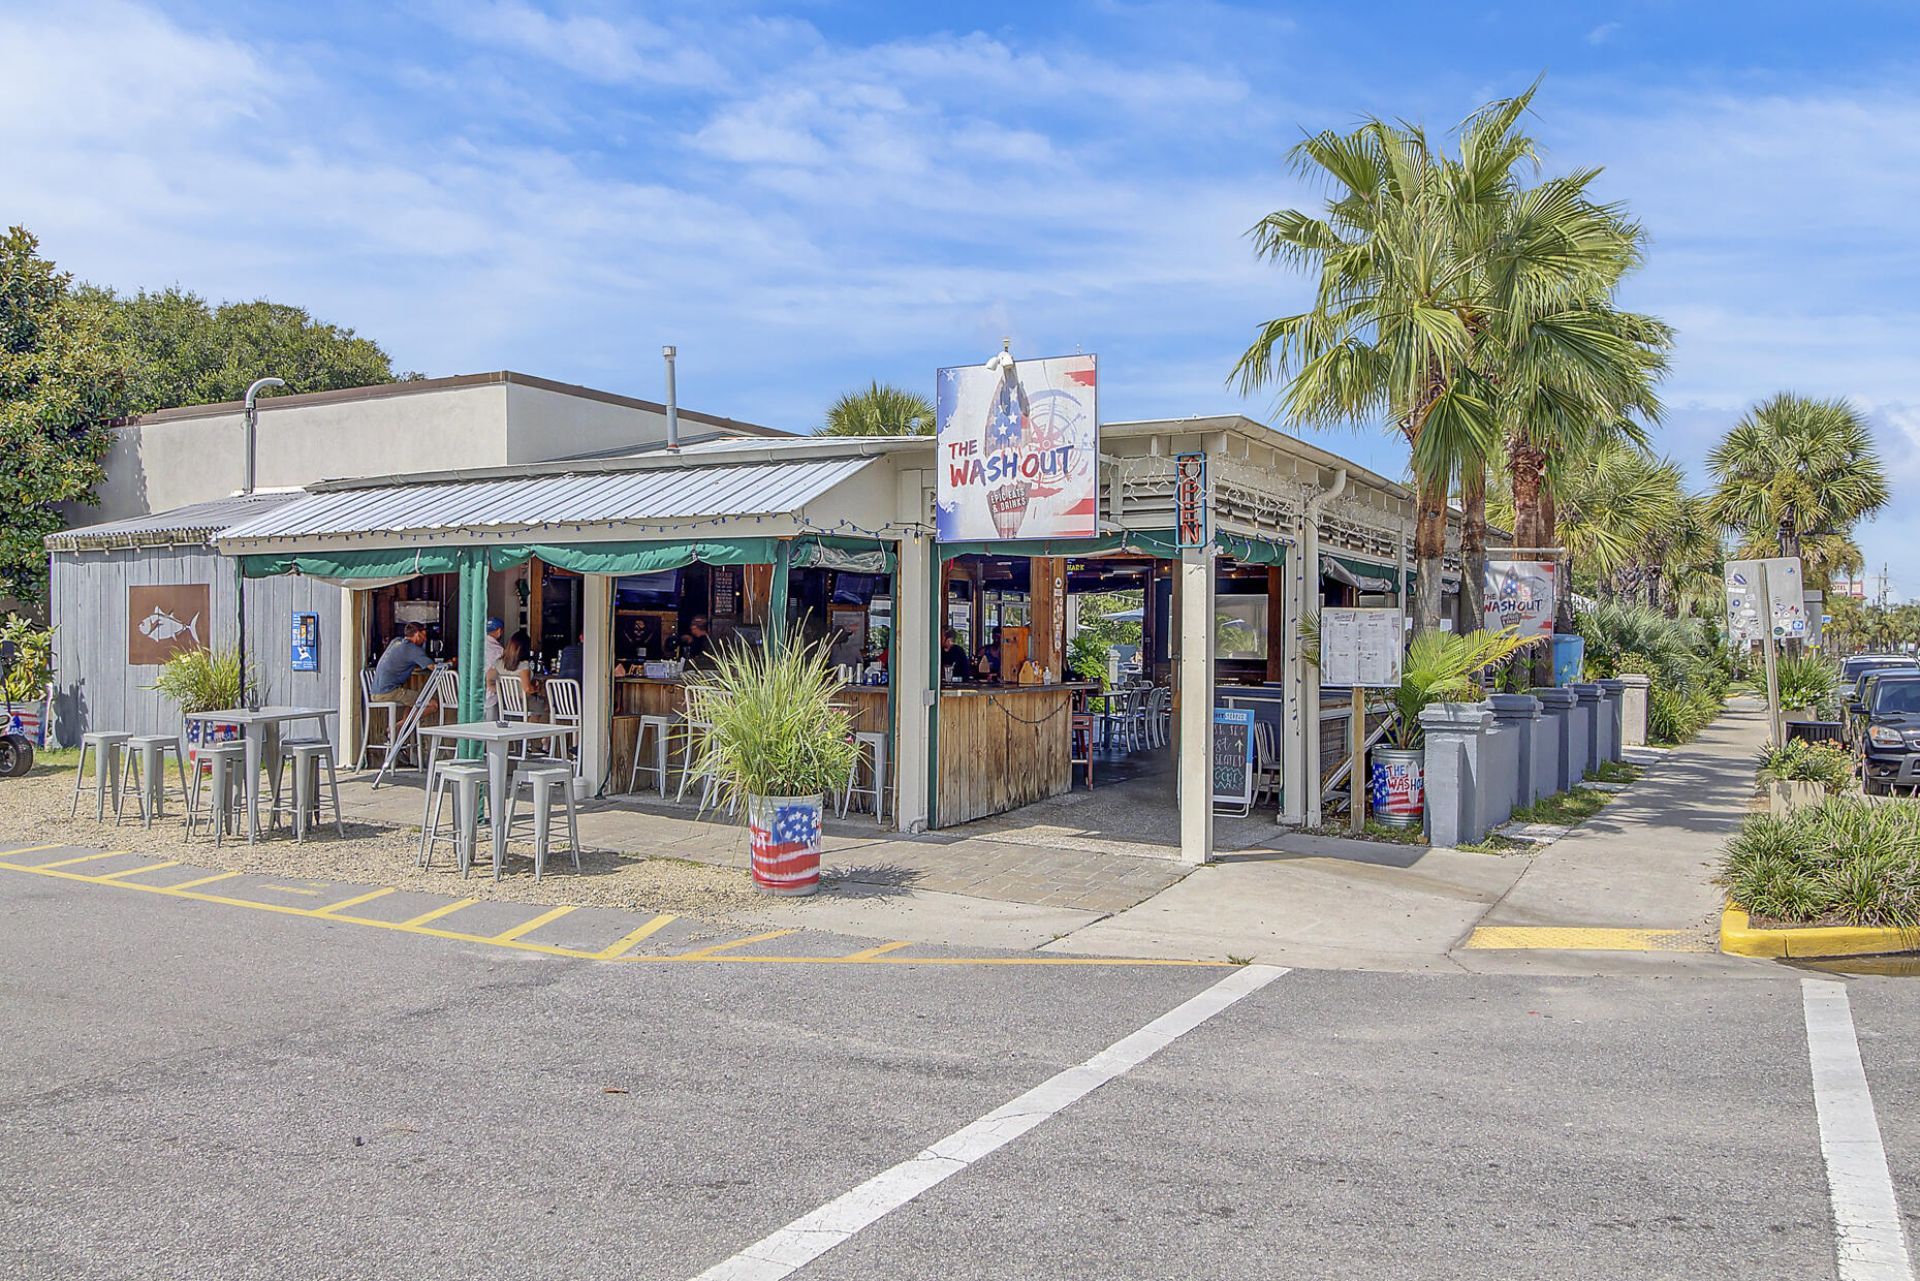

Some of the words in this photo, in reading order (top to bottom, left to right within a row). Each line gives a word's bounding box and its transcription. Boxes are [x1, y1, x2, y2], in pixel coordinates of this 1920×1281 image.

[948, 439, 978, 460] THE
[949, 445, 1074, 488] WASHOUT
[991, 491, 1007, 504] EPIC
[1008, 487, 1026, 501] EATS
[1179, 457, 1200, 544] OPEN
[1000, 497, 1027, 512] DRINKS
[1484, 599, 1543, 613] WASHOUT
[1385, 764, 1406, 777] THE
